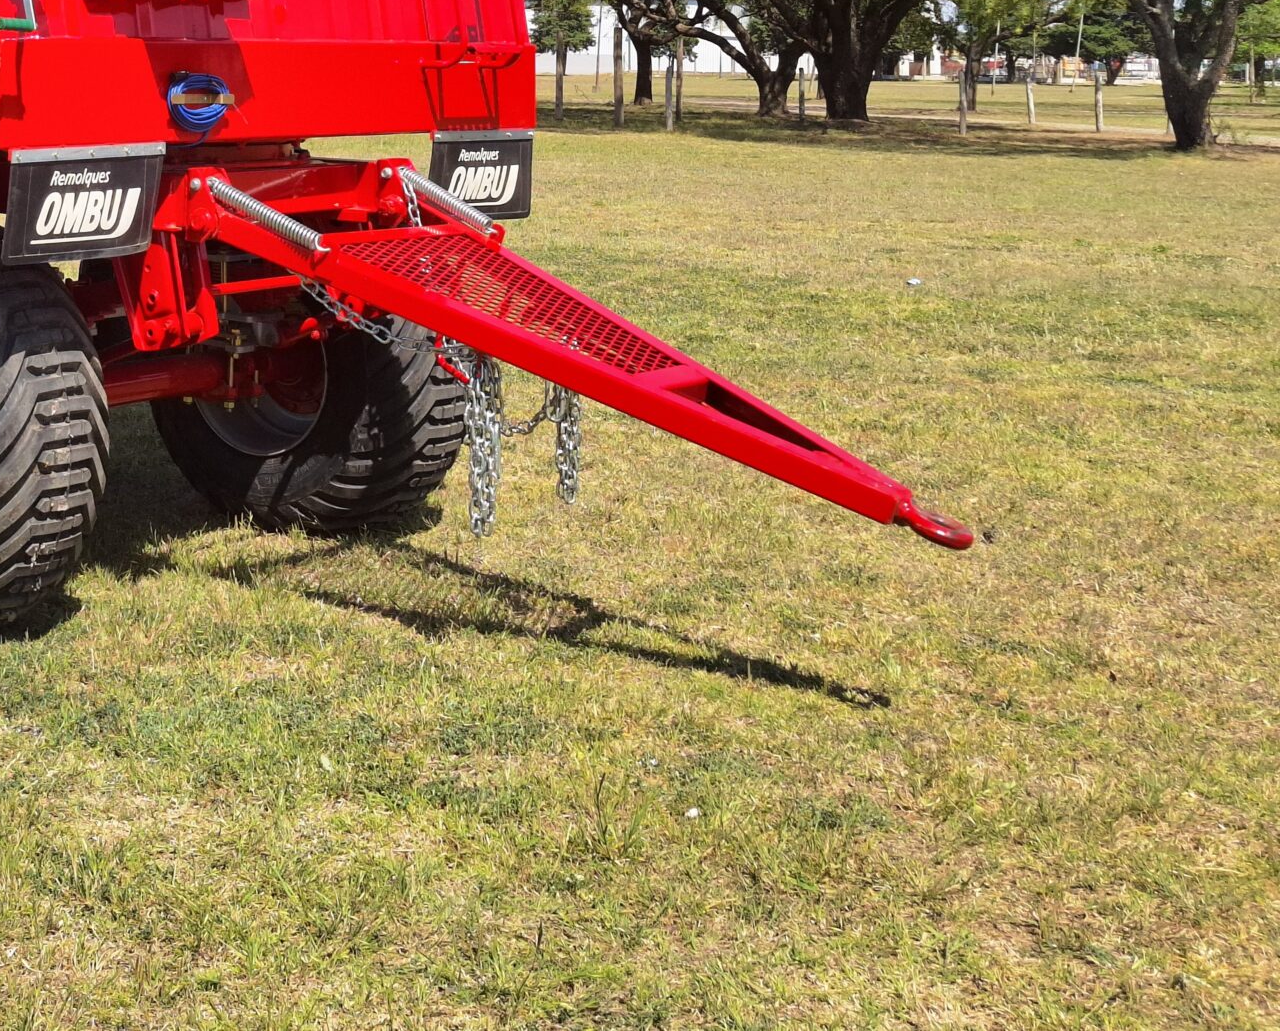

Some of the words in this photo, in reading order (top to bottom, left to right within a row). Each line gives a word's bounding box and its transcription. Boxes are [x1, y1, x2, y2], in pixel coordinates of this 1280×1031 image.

[458, 147, 500, 164] Remolques
[50, 168, 111, 188] Remolques
[448, 165, 519, 203] OMBU
[34, 188, 141, 238] OMBU
